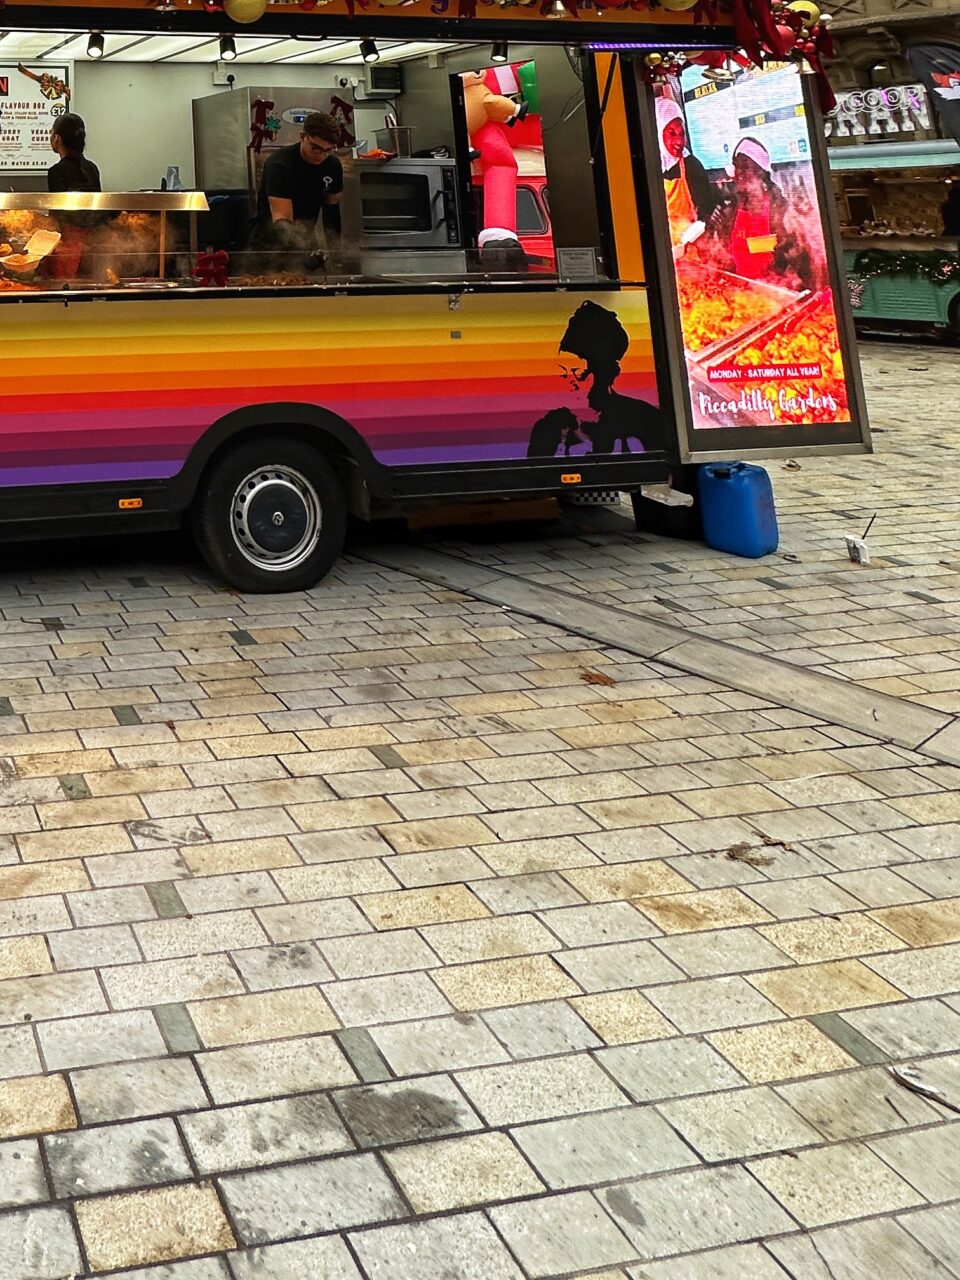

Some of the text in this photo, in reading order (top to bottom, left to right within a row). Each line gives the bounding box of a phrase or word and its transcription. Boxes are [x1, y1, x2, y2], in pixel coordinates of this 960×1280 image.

[709, 370, 742, 379] MONDAY
[748, 368, 785, 378] SATURDAY
[786, 367, 799, 376] ALL
[800, 366, 820, 376] YEAR!
[698, 386, 839, 422] Piccadilly Gardens
